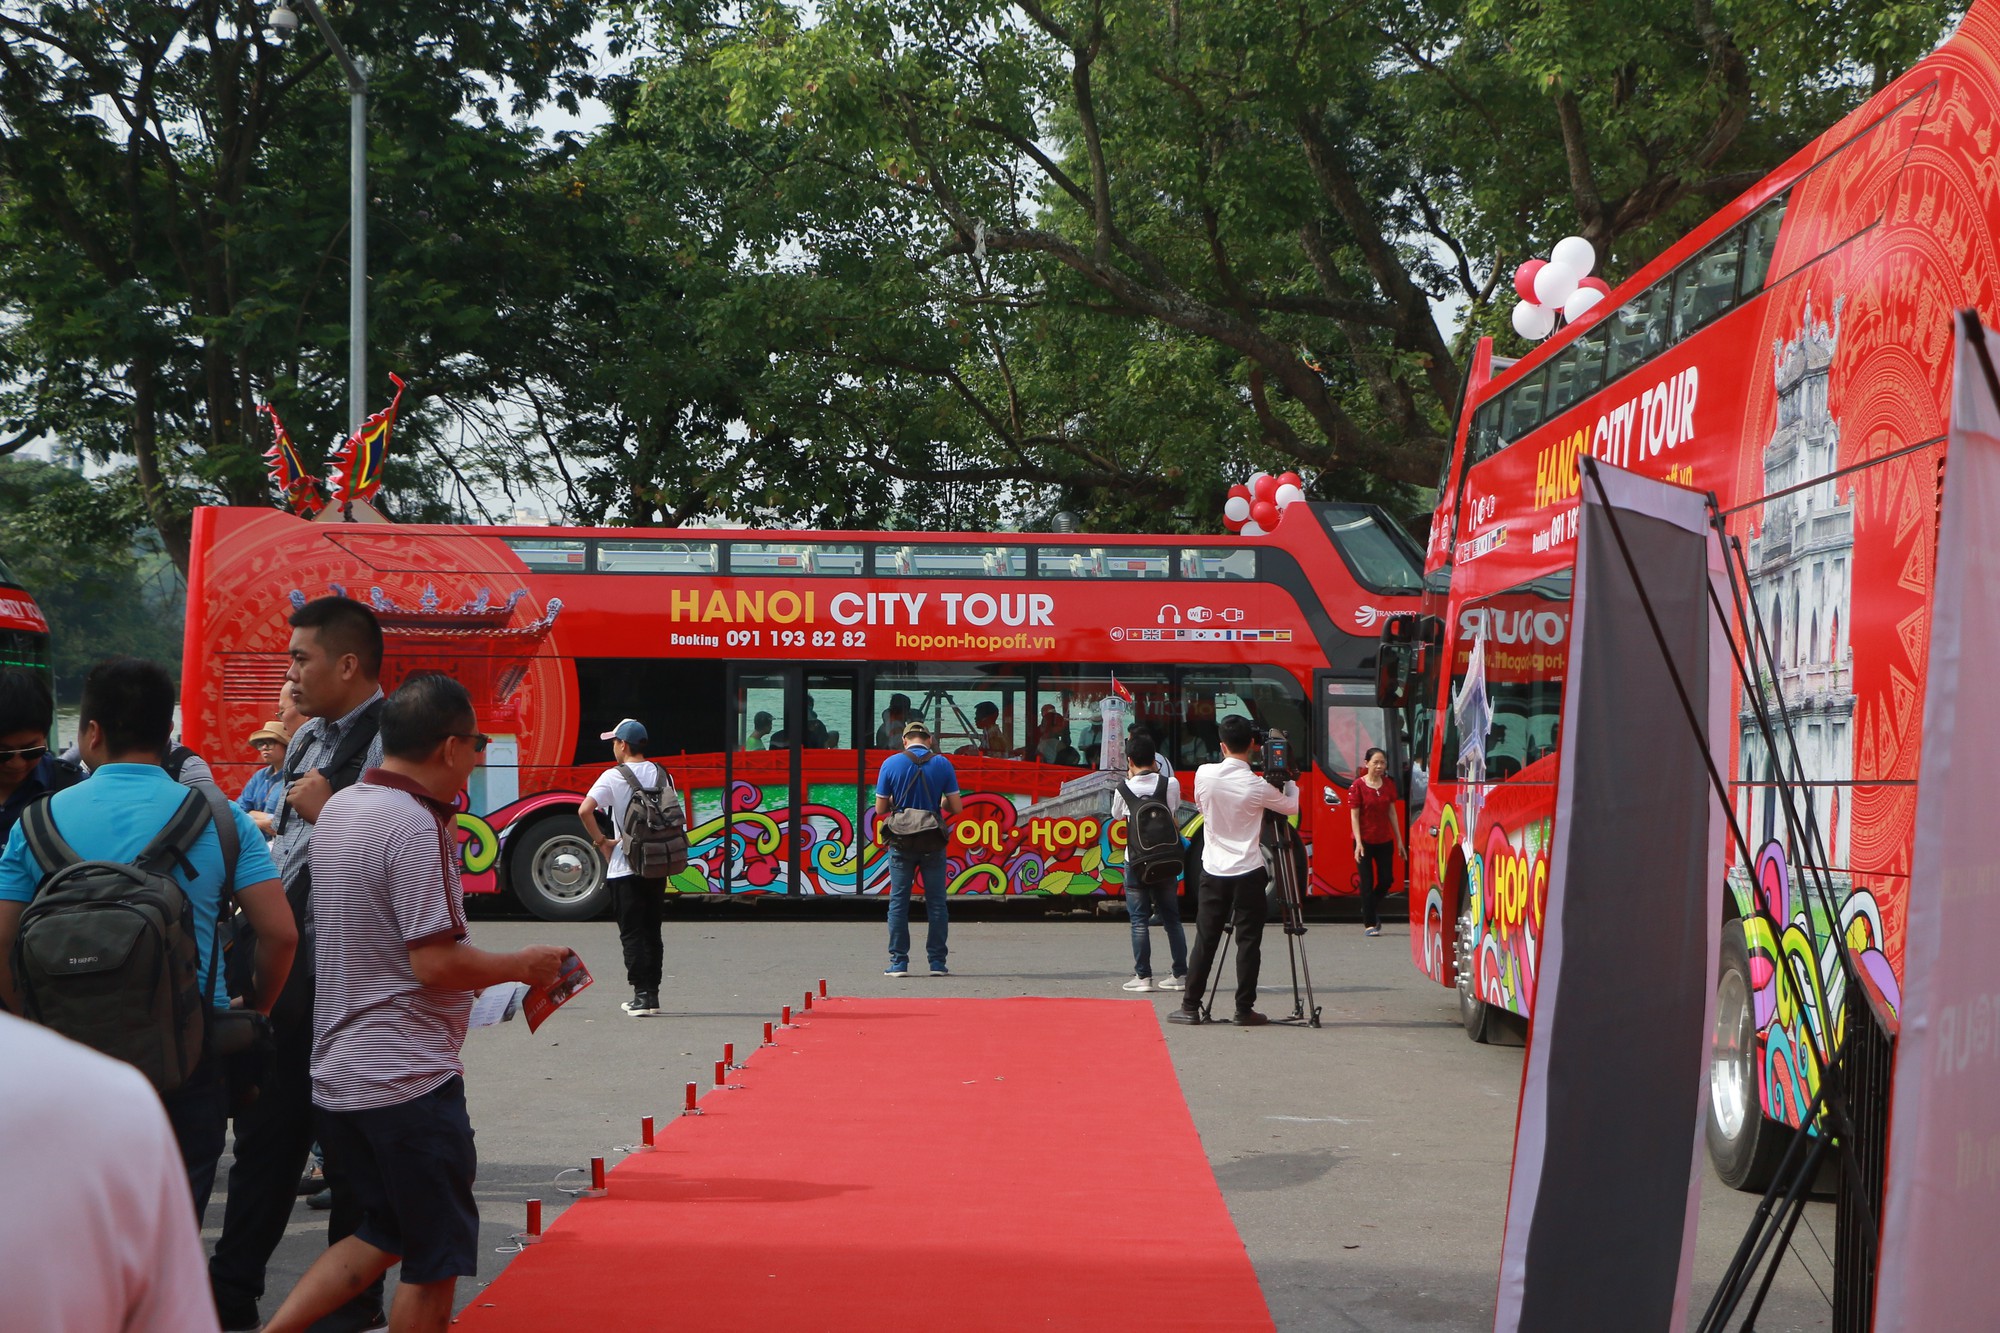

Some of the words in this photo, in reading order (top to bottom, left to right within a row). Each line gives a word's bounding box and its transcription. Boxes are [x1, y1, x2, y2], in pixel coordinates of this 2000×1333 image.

[1592, 398, 1637, 468] CITY
[1639, 366, 1698, 461] TOUR
[1551, 512, 1565, 547] 091
[671, 589, 814, 624] HANOI
[830, 592, 927, 625] CITY
[941, 592, 1054, 627] TOUR
[671, 633, 719, 648] Booking
[726, 630, 760, 647] 091
[770, 631, 806, 647] 193
[811, 631, 836, 647] 82
[842, 632, 866, 647] 82
[895, 631, 1056, 652] hopon-hopoff.vn
[1031, 820, 1097, 852] HOP
[1494, 853, 1529, 941] HOP
